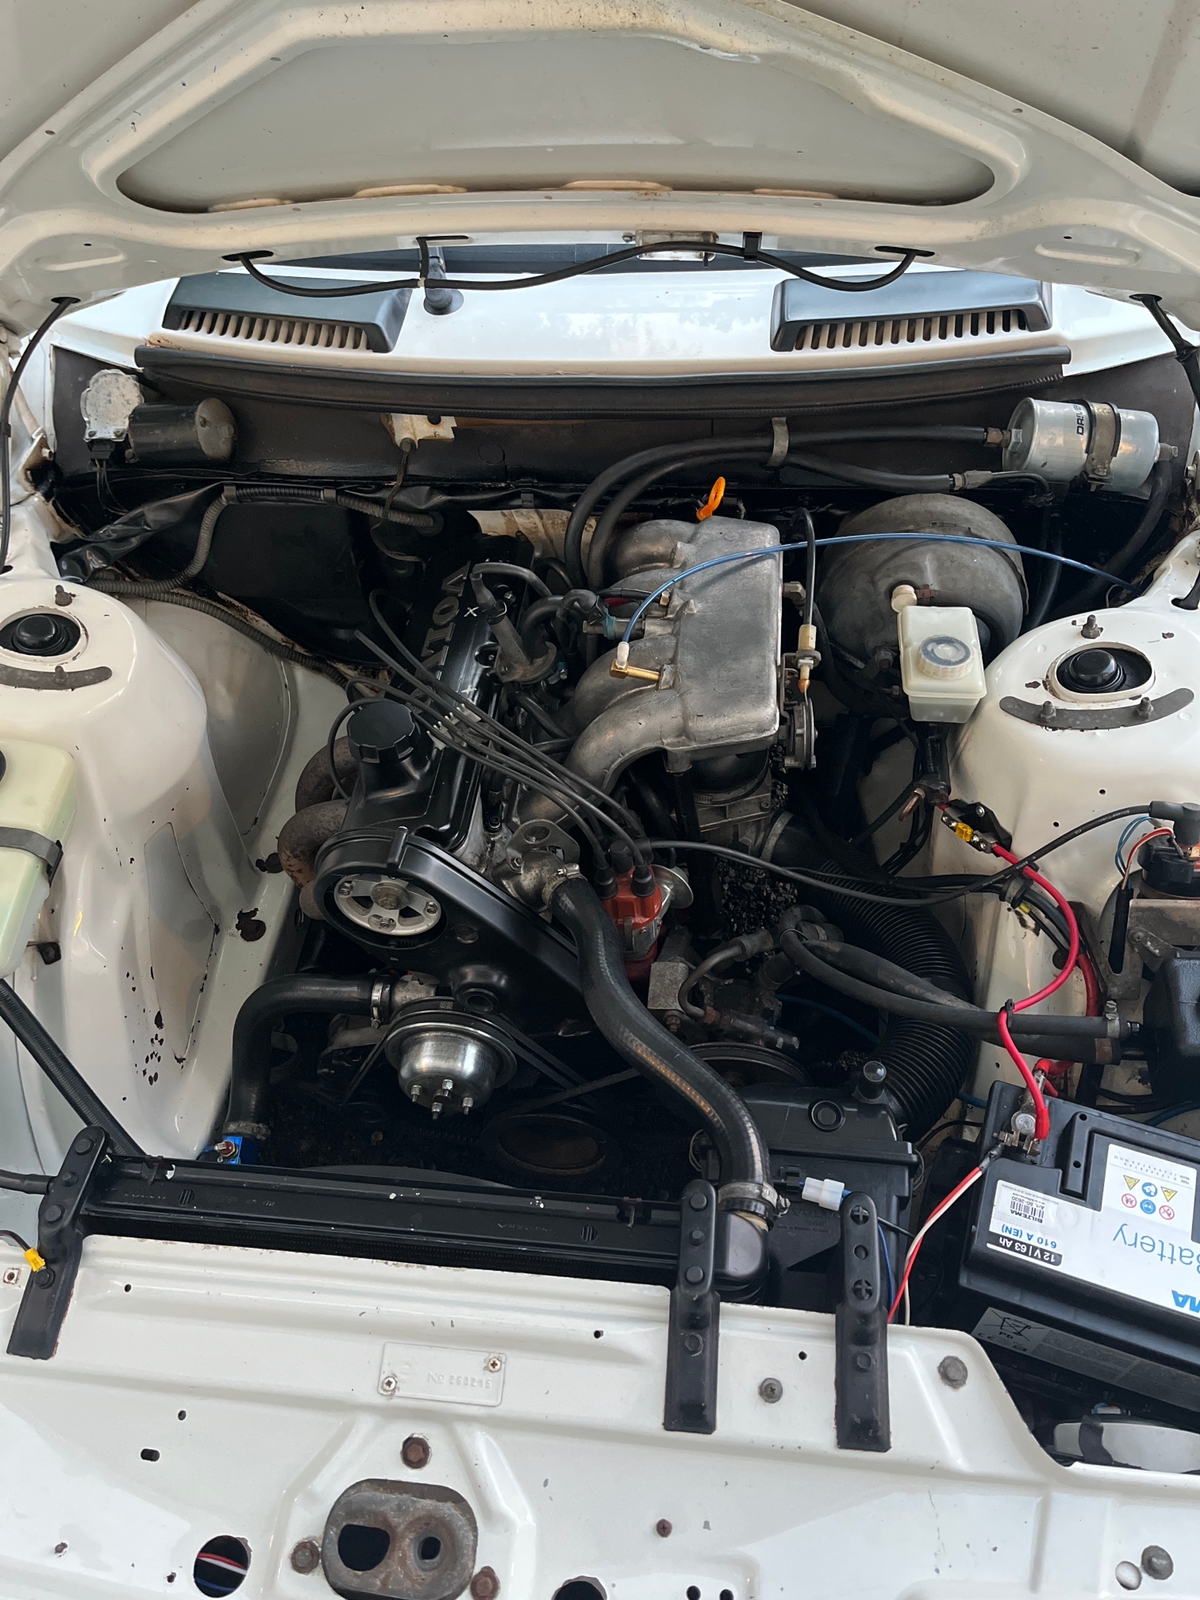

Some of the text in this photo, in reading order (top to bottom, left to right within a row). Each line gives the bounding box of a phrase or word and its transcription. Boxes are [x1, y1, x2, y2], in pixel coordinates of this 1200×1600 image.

[1010, 1209, 1043, 1224] BILTEMA
[999, 1236, 1014, 1248] Ah
[1001, 1223, 1057, 1249] 610 A (EN)
[1014, 1242, 1027, 1253] 63
[1033, 1248, 1041, 1259] V
[1043, 1251, 1056, 1263] 12
